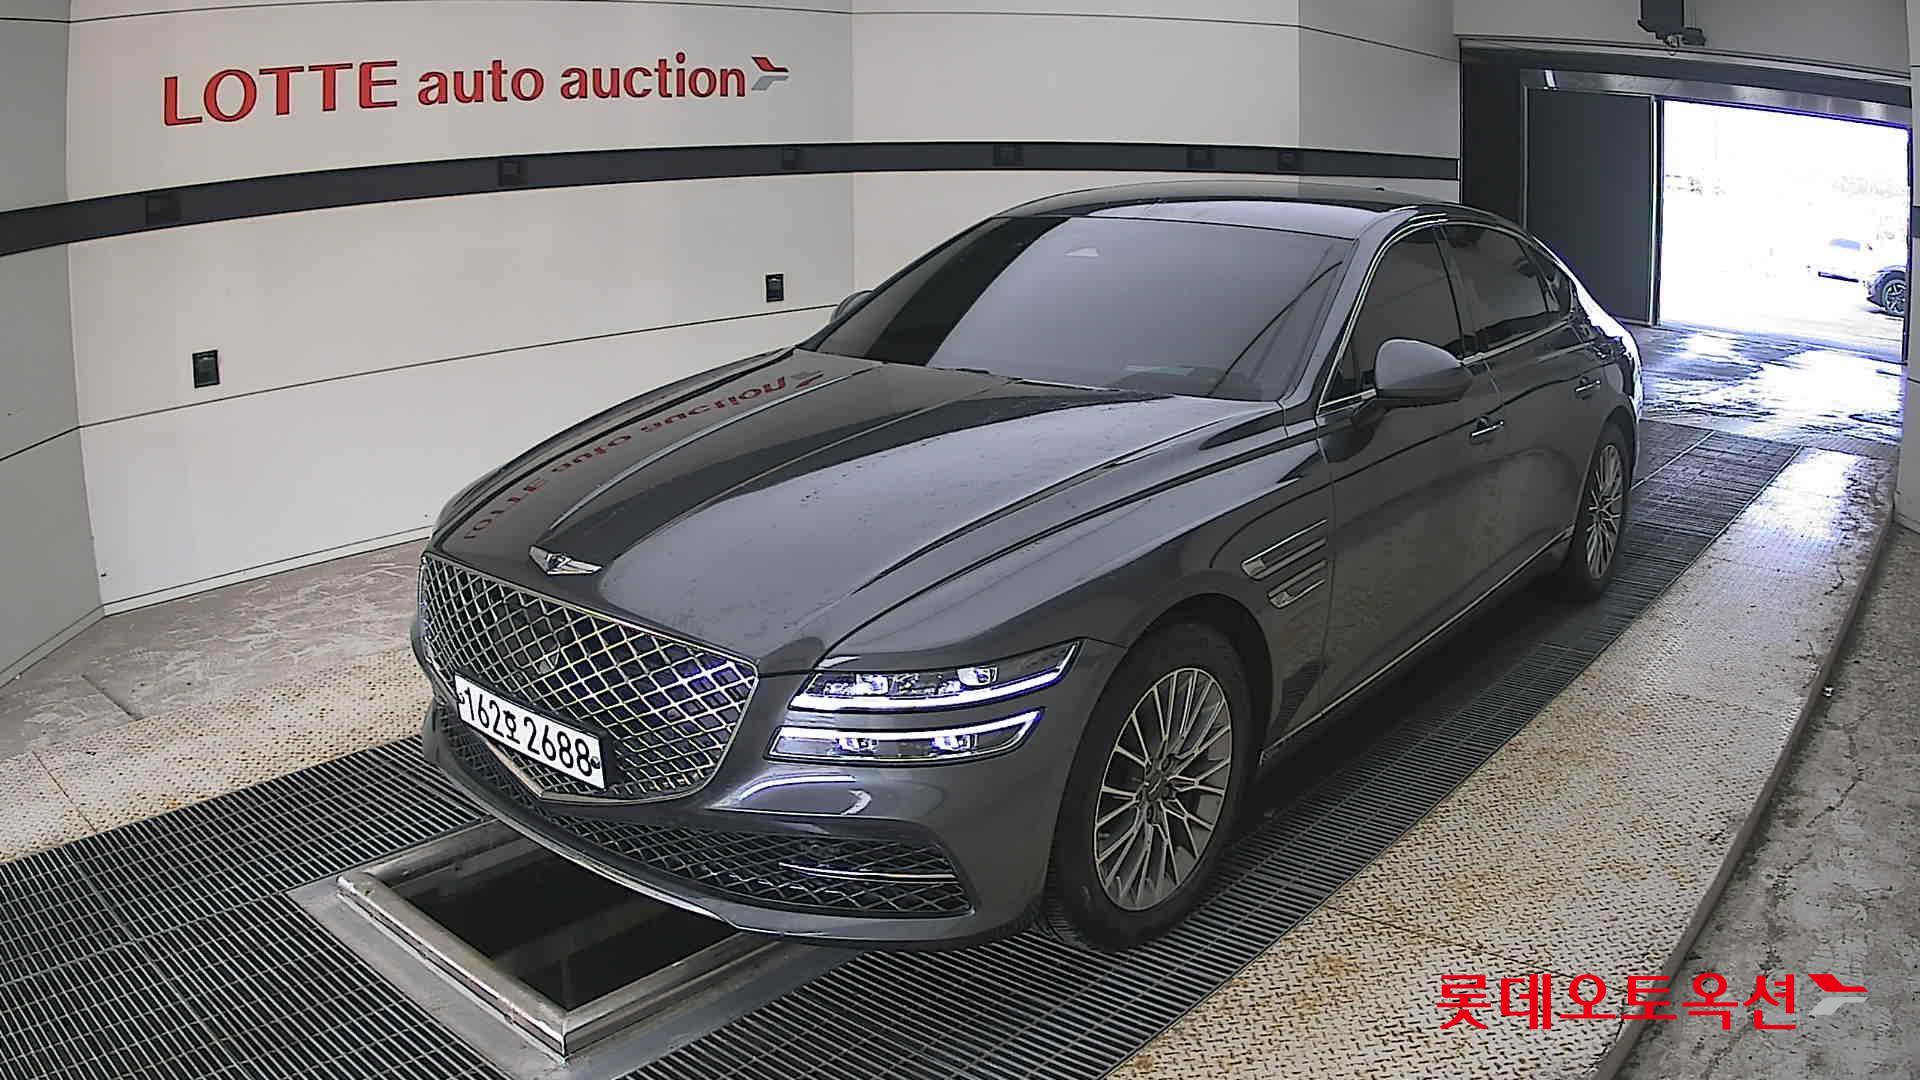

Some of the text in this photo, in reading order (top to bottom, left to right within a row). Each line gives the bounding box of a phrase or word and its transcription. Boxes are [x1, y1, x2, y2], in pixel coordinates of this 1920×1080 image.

[163, 51, 747, 127] LOTTE auto auction
